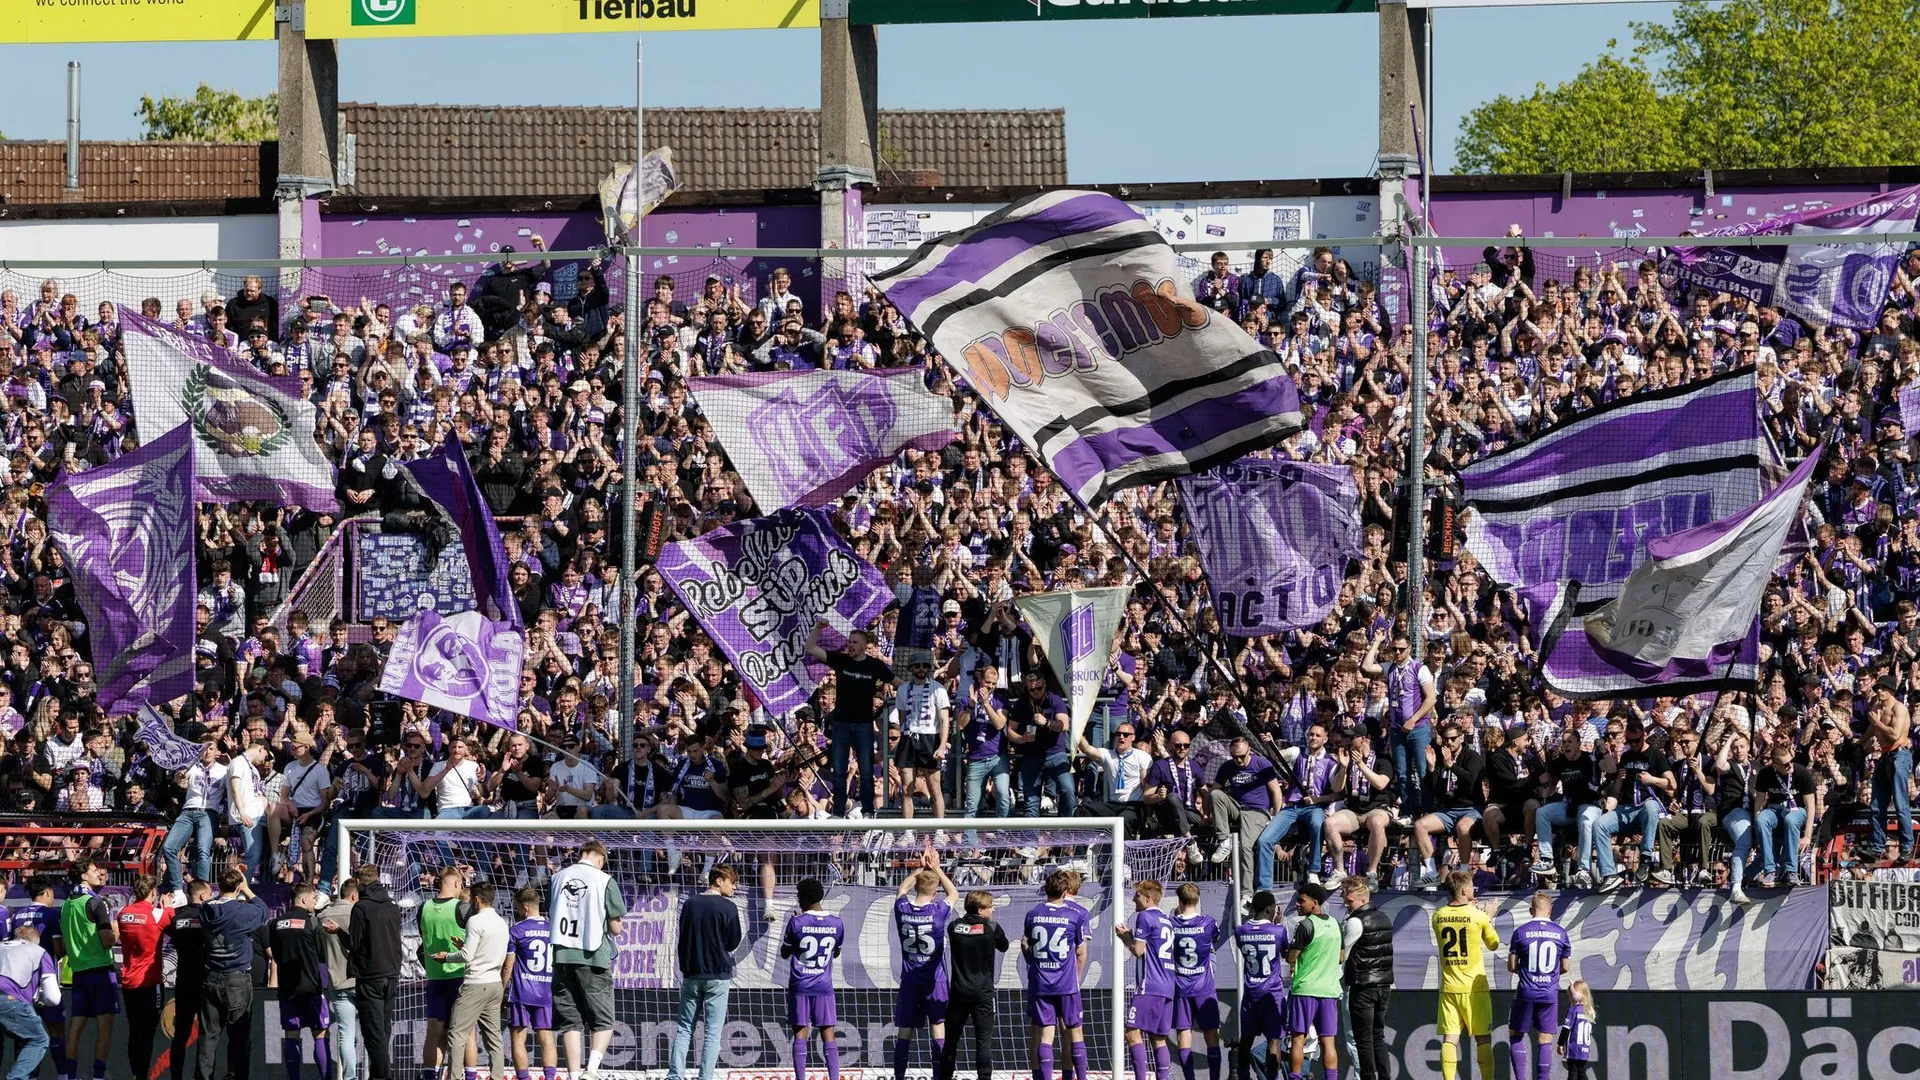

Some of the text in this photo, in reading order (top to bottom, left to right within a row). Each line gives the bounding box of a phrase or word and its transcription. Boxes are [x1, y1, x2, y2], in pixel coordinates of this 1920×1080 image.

[575, 0, 697, 20] Tiefbau
[646, 510, 663, 557] BECKHOFF
[559, 917, 579, 938] 01
[902, 924, 936, 954] 25
[1031, 925, 1070, 959] 24
[1441, 926, 1468, 958] 21
[799, 935, 837, 968] 23
[1178, 937, 1199, 968] 3
[1241, 943, 1276, 976] 37
[1528, 940, 1558, 974] 10
